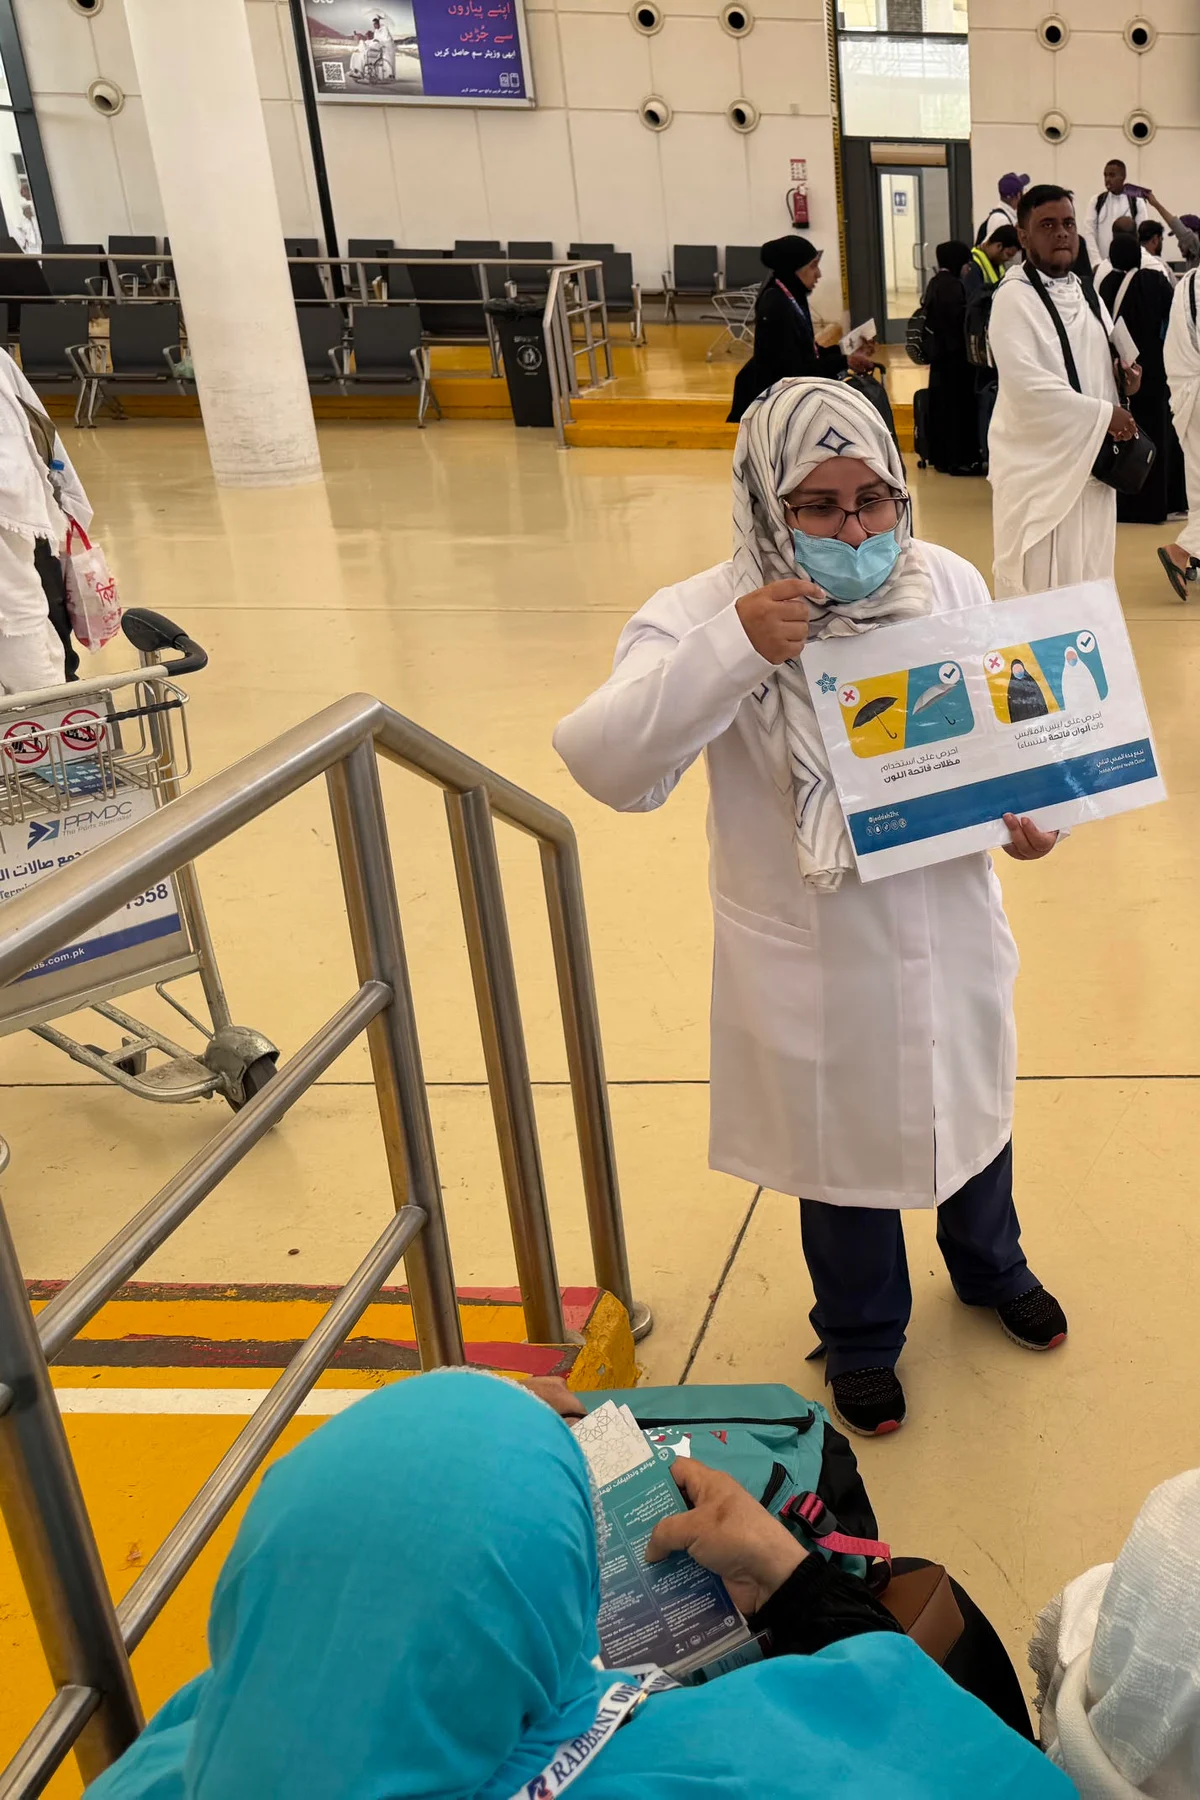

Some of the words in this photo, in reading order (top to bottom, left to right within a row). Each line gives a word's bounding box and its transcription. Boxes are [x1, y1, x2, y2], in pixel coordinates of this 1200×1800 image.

[487, 2, 511, 20] اپنے
[494, 34, 513, 43] سے
[434, 47, 450, 58] کریں
[451, 48, 470, 57] حاصل
[1048, 731, 1071, 741] فاتحة
[916, 753, 935, 764] على
[933, 758, 961, 770] مظلات
[880, 757, 916, 773] استخدام
[908, 764, 932, 776] فاتحة
[883, 770, 907, 783] اللون
[63, 801, 133, 830] PPMDC
[13, 859, 54, 877] صالات
[550, 1707, 621, 1787] RABBANI
